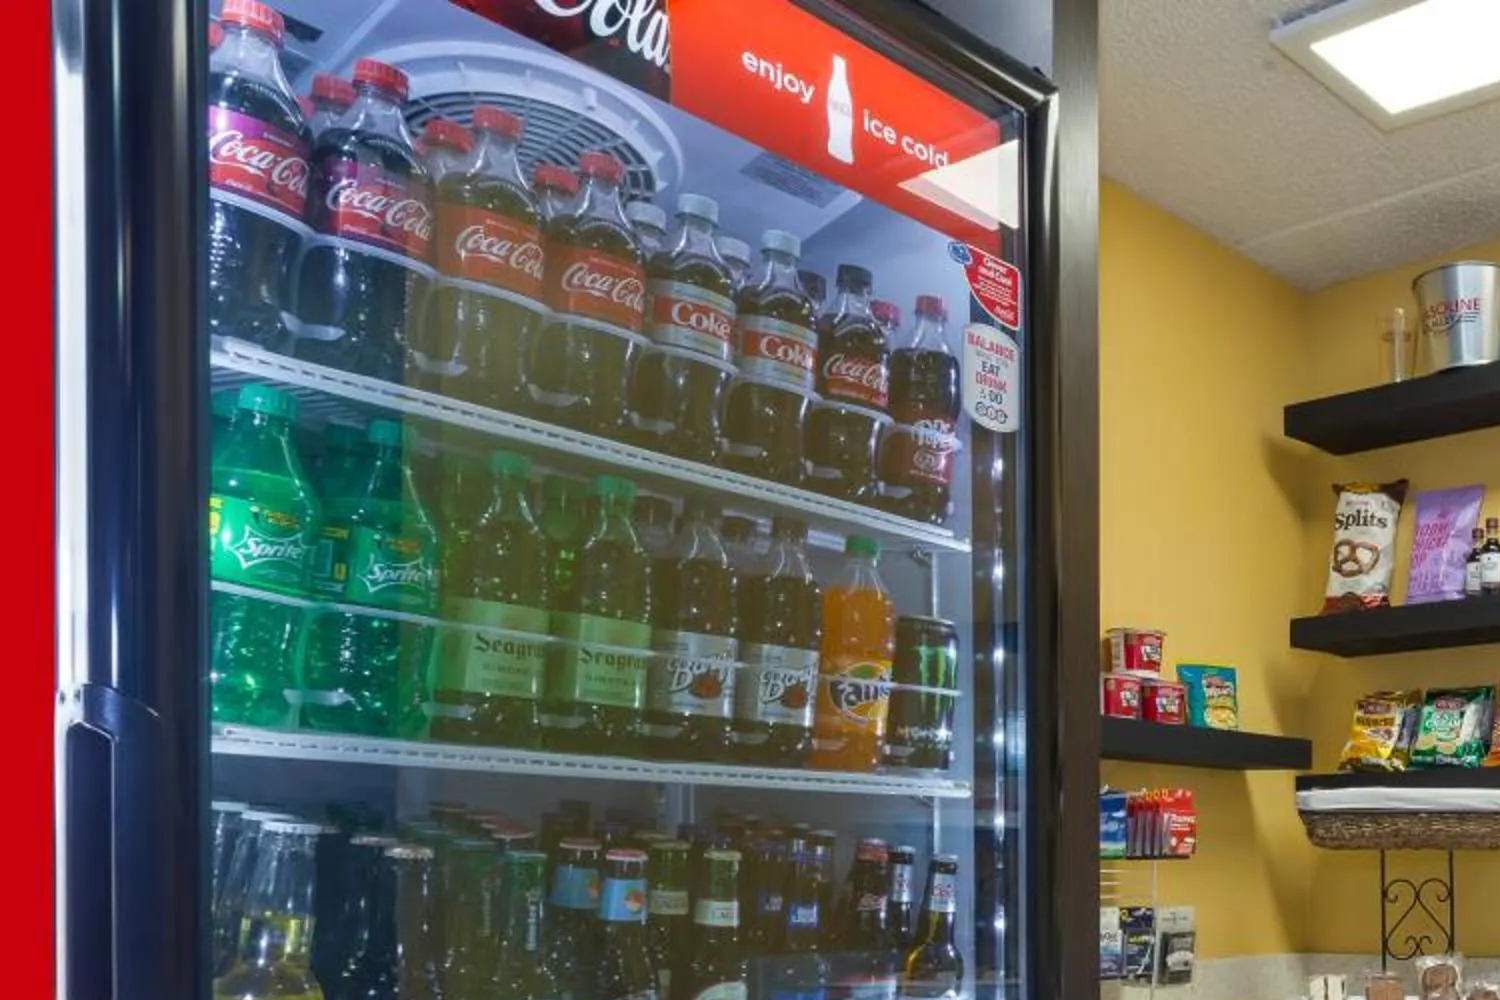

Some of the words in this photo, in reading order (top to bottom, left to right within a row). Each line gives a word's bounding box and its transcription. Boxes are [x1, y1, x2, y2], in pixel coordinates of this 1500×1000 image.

[741, 51, 815, 104] enjoy
[863, 109, 897, 144] ice
[901, 134, 950, 173] cold
[671, 301, 731, 336] Coke
[981, 361, 1001, 377] EAT
